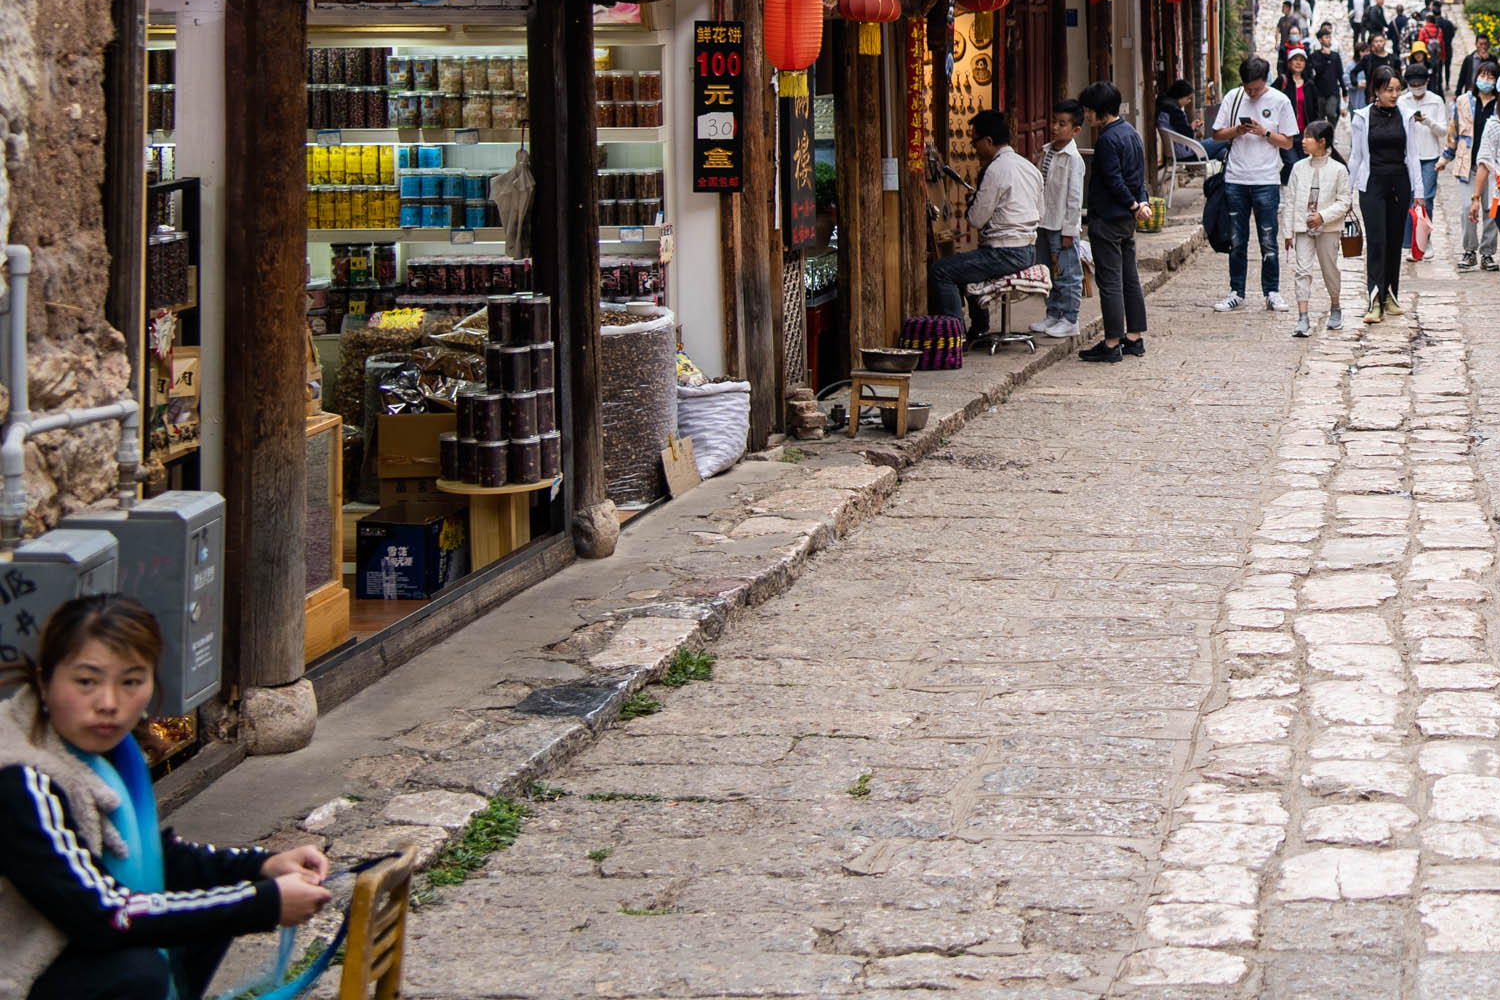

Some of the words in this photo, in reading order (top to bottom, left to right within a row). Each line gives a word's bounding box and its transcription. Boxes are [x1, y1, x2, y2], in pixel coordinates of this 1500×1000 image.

[696, 26, 742, 44] 鲜花饼
[697, 52, 741, 77] 100
[703, 84, 734, 105] 元
[708, 118, 732, 137] 30
[703, 147, 734, 168] 盒
